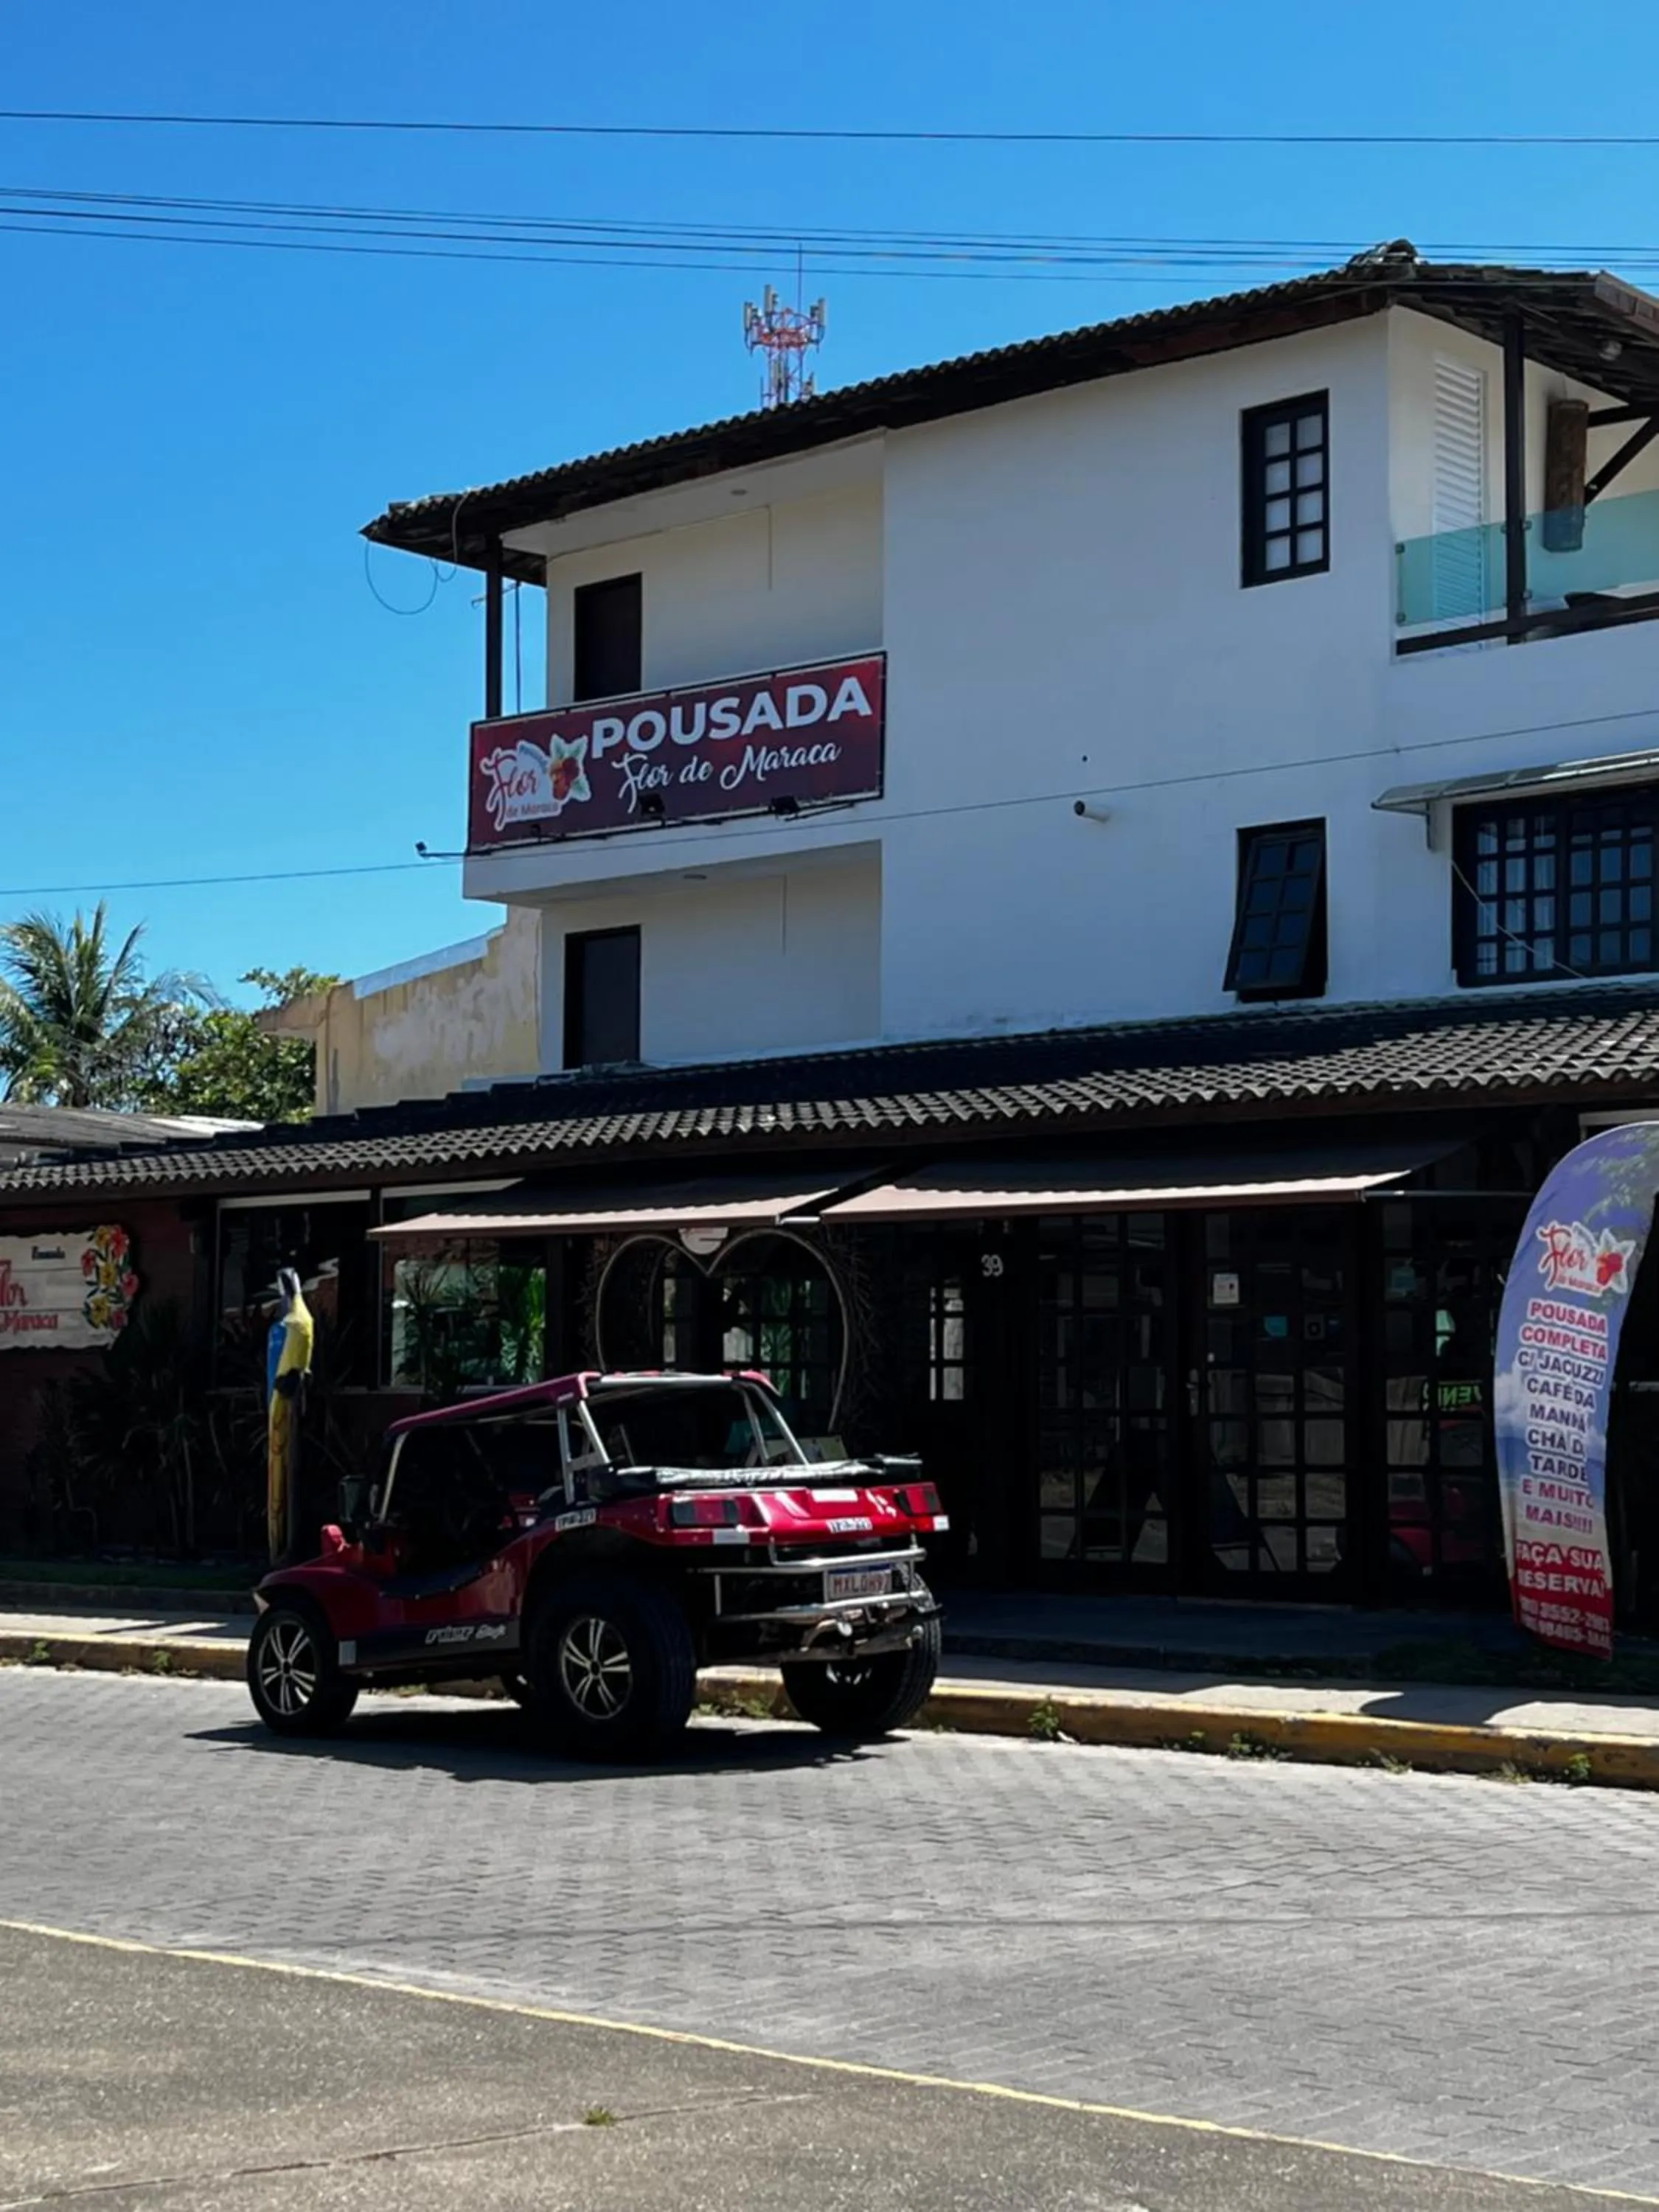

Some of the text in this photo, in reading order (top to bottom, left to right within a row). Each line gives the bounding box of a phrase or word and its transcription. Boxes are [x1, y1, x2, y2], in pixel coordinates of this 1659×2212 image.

[591, 676, 873, 759] POUSADA
[483, 752, 537, 827] Flor
[612, 742, 843, 813] Flor de Maraca
[979, 1253, 997, 1272] 39
[1540, 1226, 1585, 1286] Flor
[1531, 1301, 1606, 1334] POUSADA
[1522, 1326, 1606, 1359] COMPLETA
[1518, 1351, 1604, 1385] C/ JACUZZI
[1523, 1478, 1531, 1495] E
[1569, 1548, 1604, 1571] SUA
